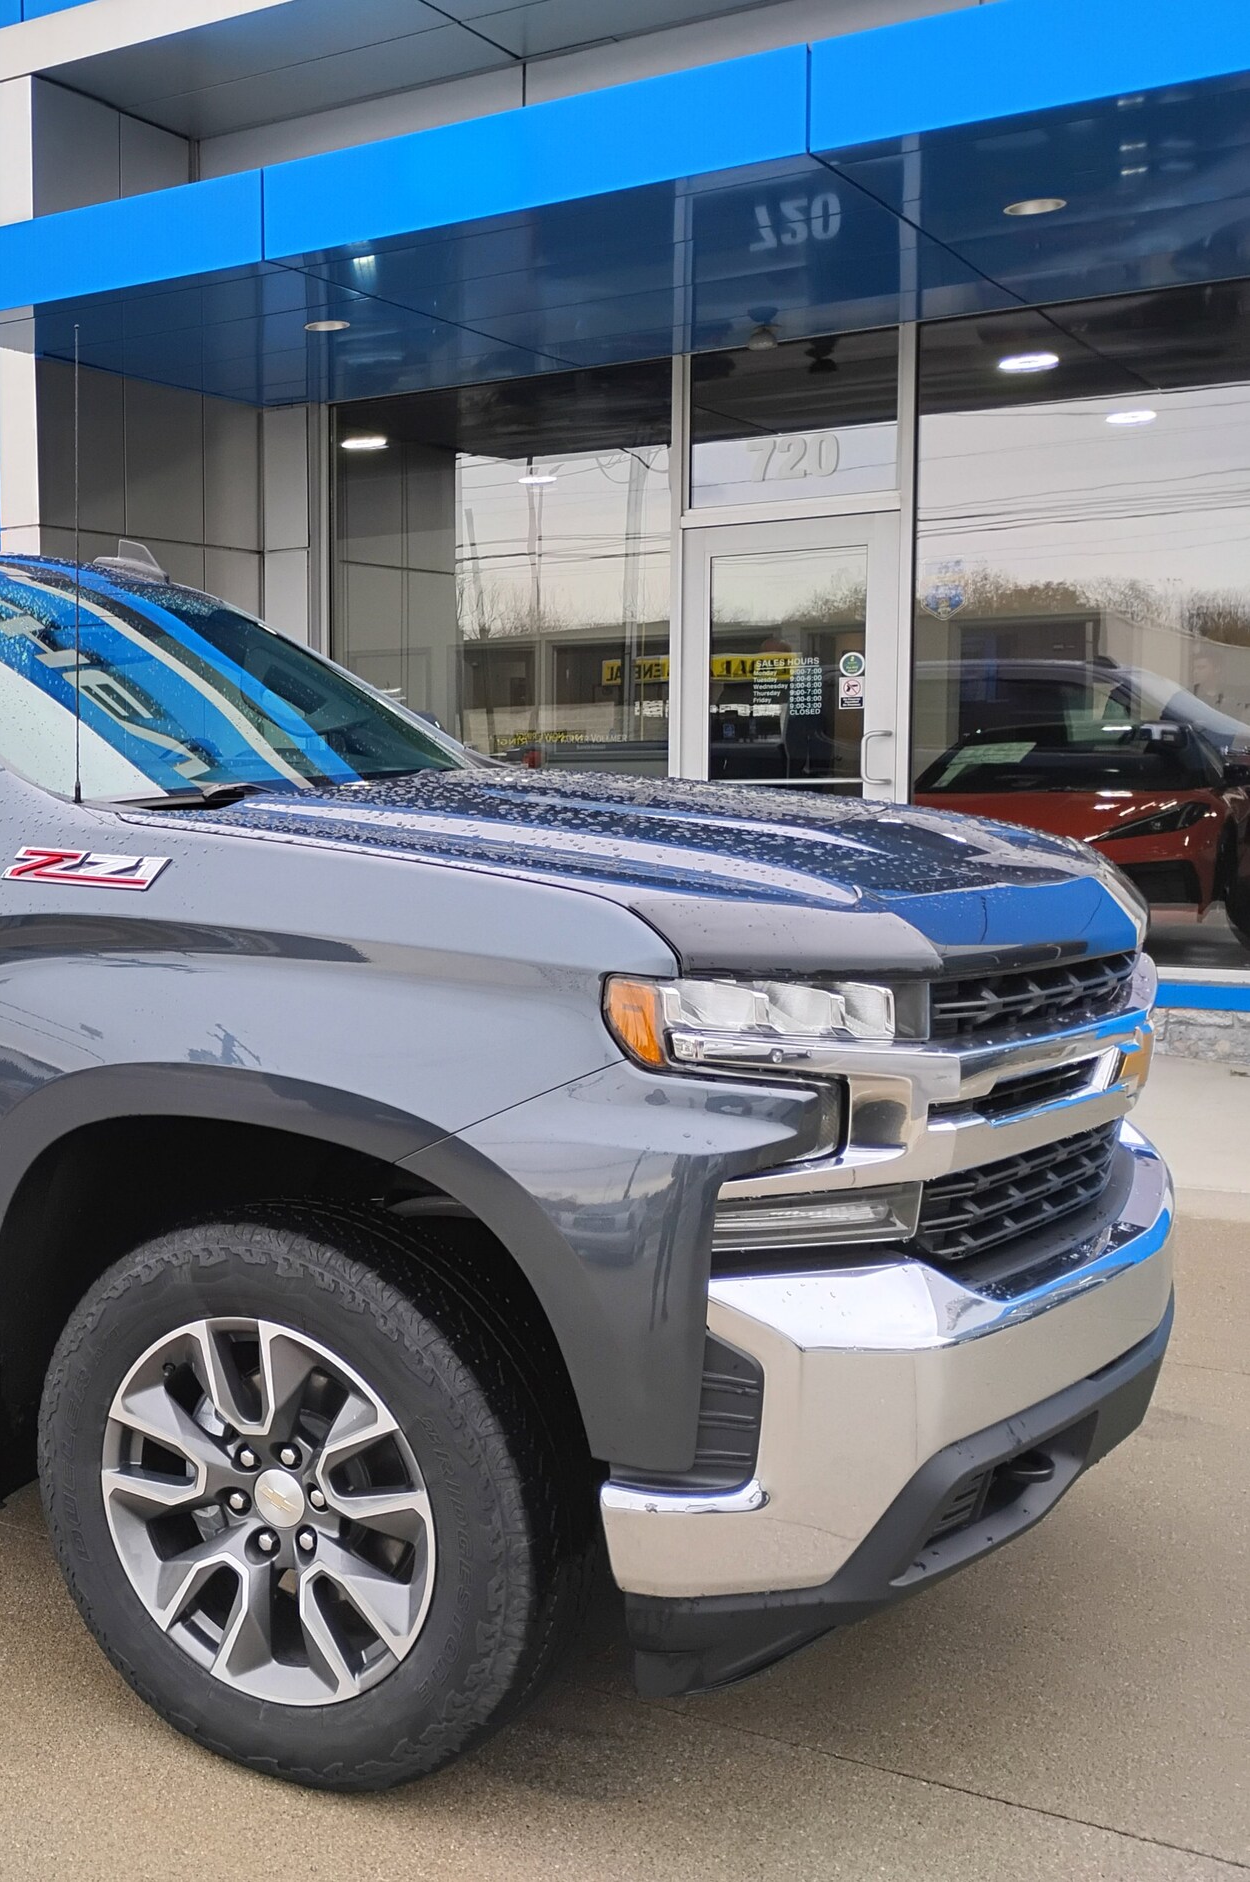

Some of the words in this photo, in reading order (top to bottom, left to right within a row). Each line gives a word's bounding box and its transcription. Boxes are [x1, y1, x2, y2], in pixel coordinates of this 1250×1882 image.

[747, 433, 840, 482] 720
[755, 658, 785, 668] SALES
[787, 656, 820, 666] HOURS
[789, 708, 821, 716] CLOSED
[1, 846, 172, 891] Z71
[61, 1366, 92, 1562] DUELER
[414, 1414, 474, 1706] BRIDGESTONE
